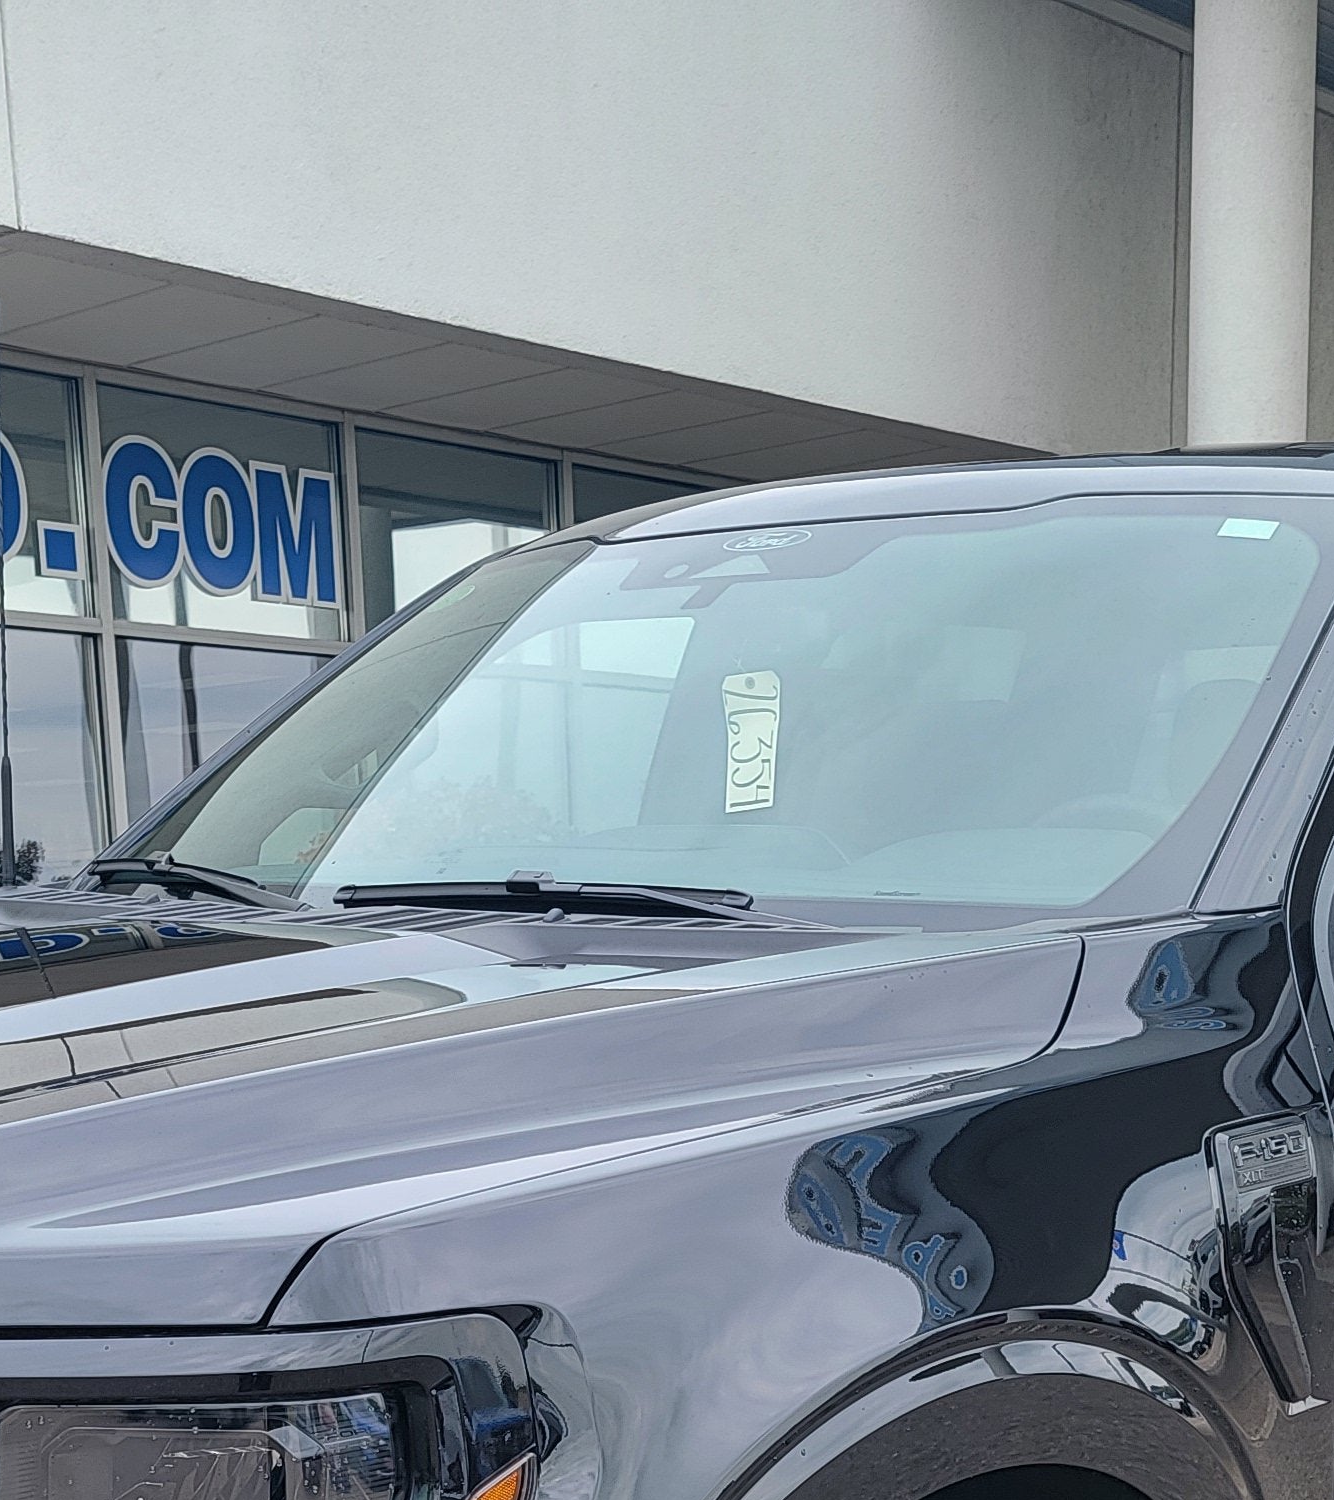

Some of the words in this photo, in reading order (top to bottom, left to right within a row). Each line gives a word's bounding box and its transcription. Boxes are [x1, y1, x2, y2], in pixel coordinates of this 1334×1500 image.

[723, 684, 778, 809] 26354
[1232, 1129, 1307, 1168] F-150
[1242, 1168, 1265, 1185] XLT
